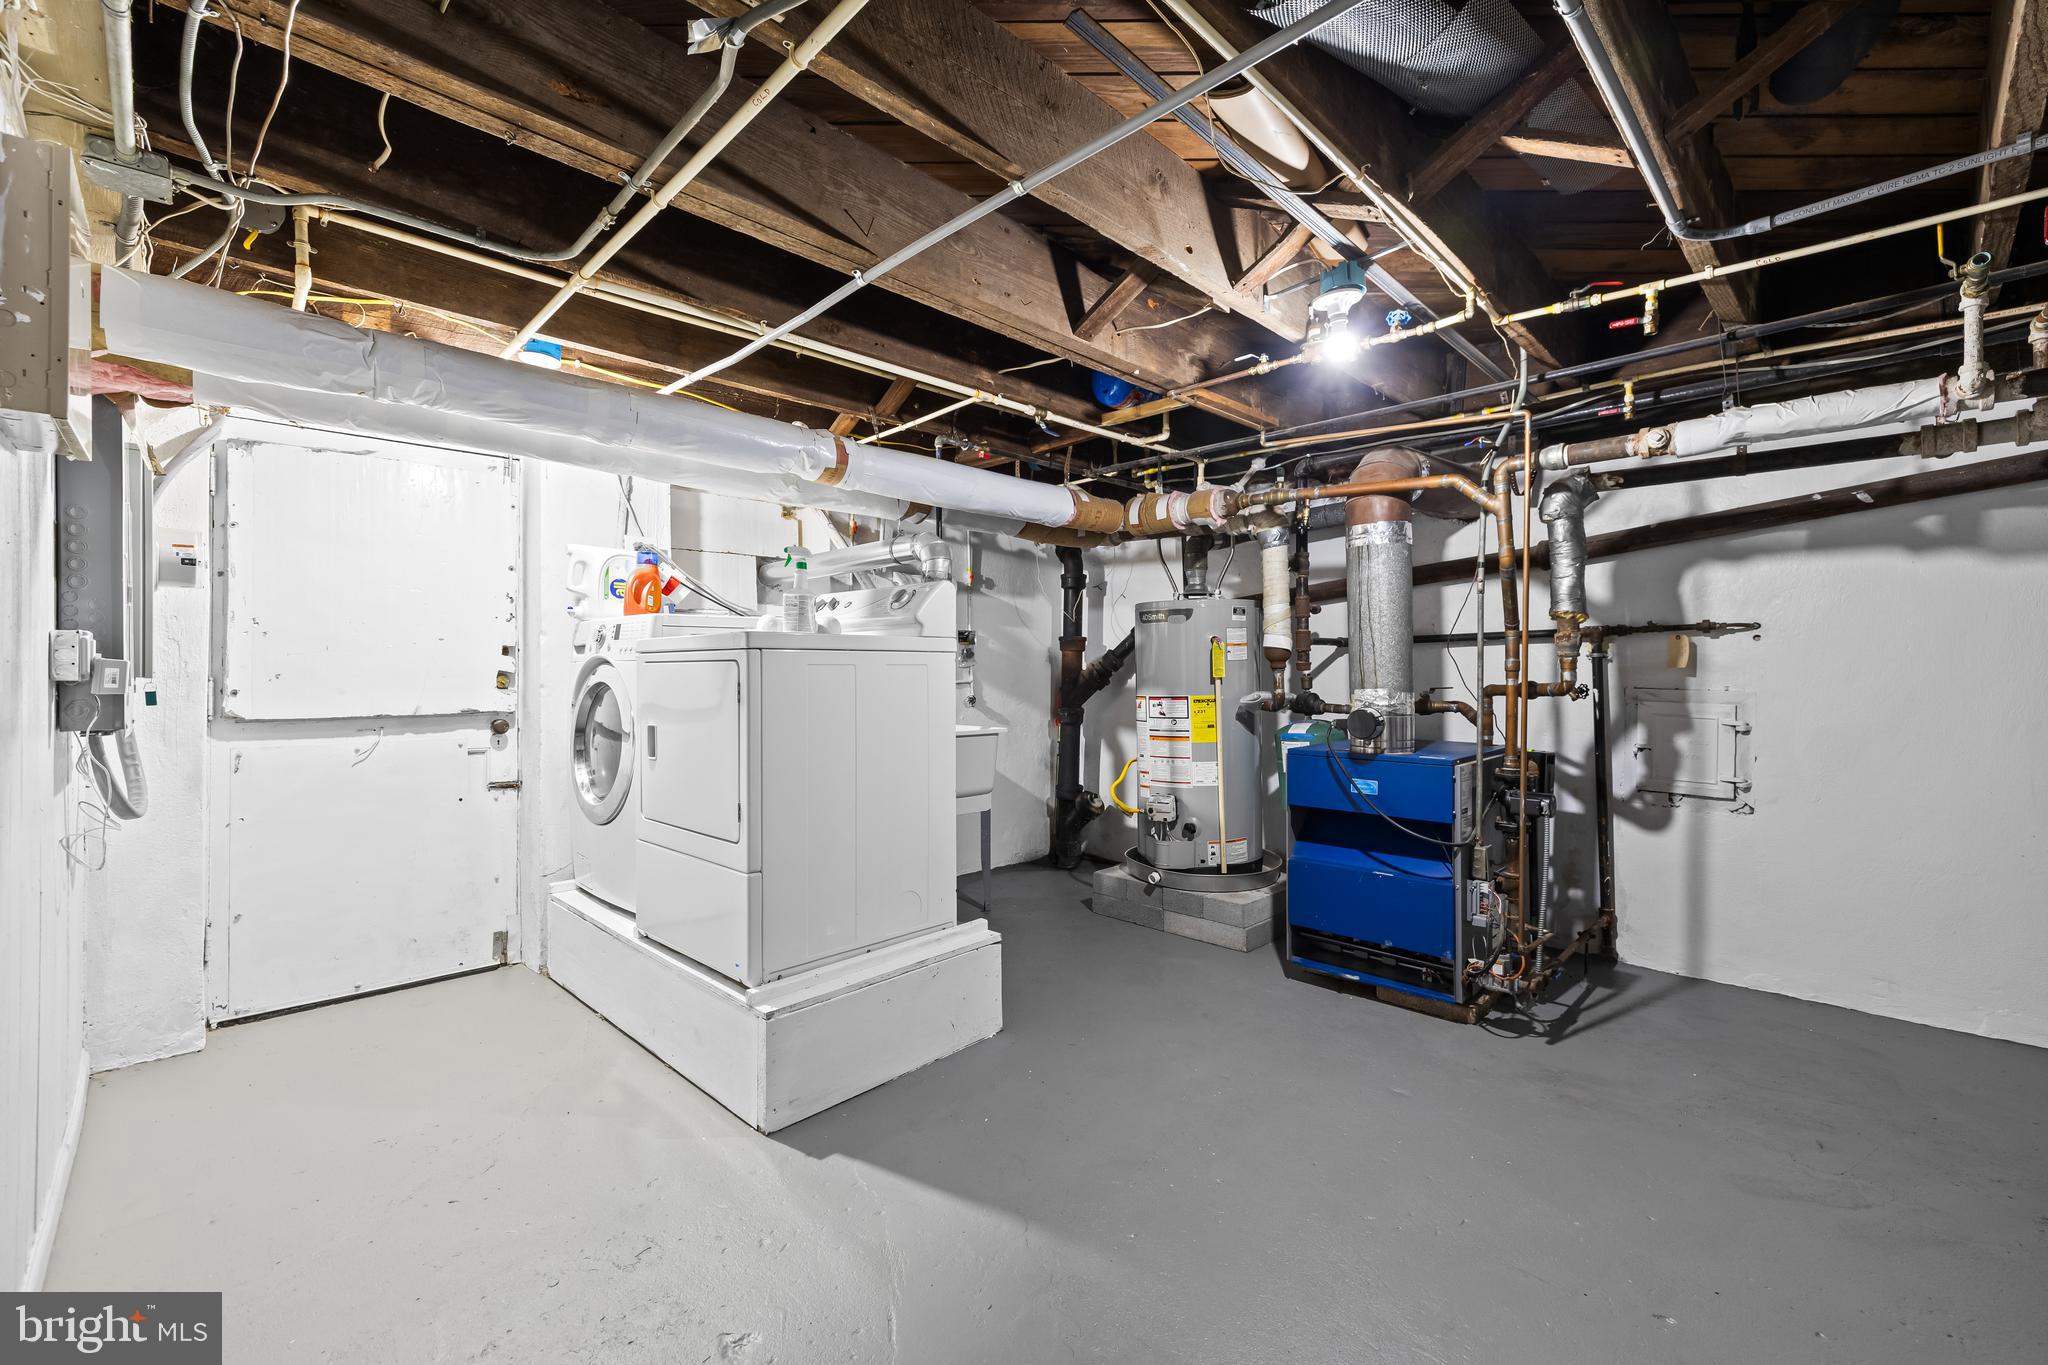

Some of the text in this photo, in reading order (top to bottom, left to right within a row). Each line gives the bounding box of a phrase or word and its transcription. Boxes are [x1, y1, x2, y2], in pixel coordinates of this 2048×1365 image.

[1792, 201, 1830, 219] CONDUIT
[1876, 179, 1900, 193] WIRE
[1902, 172, 1930, 186] NEMA
[1957, 149, 2009, 170] SUNLIGHT
